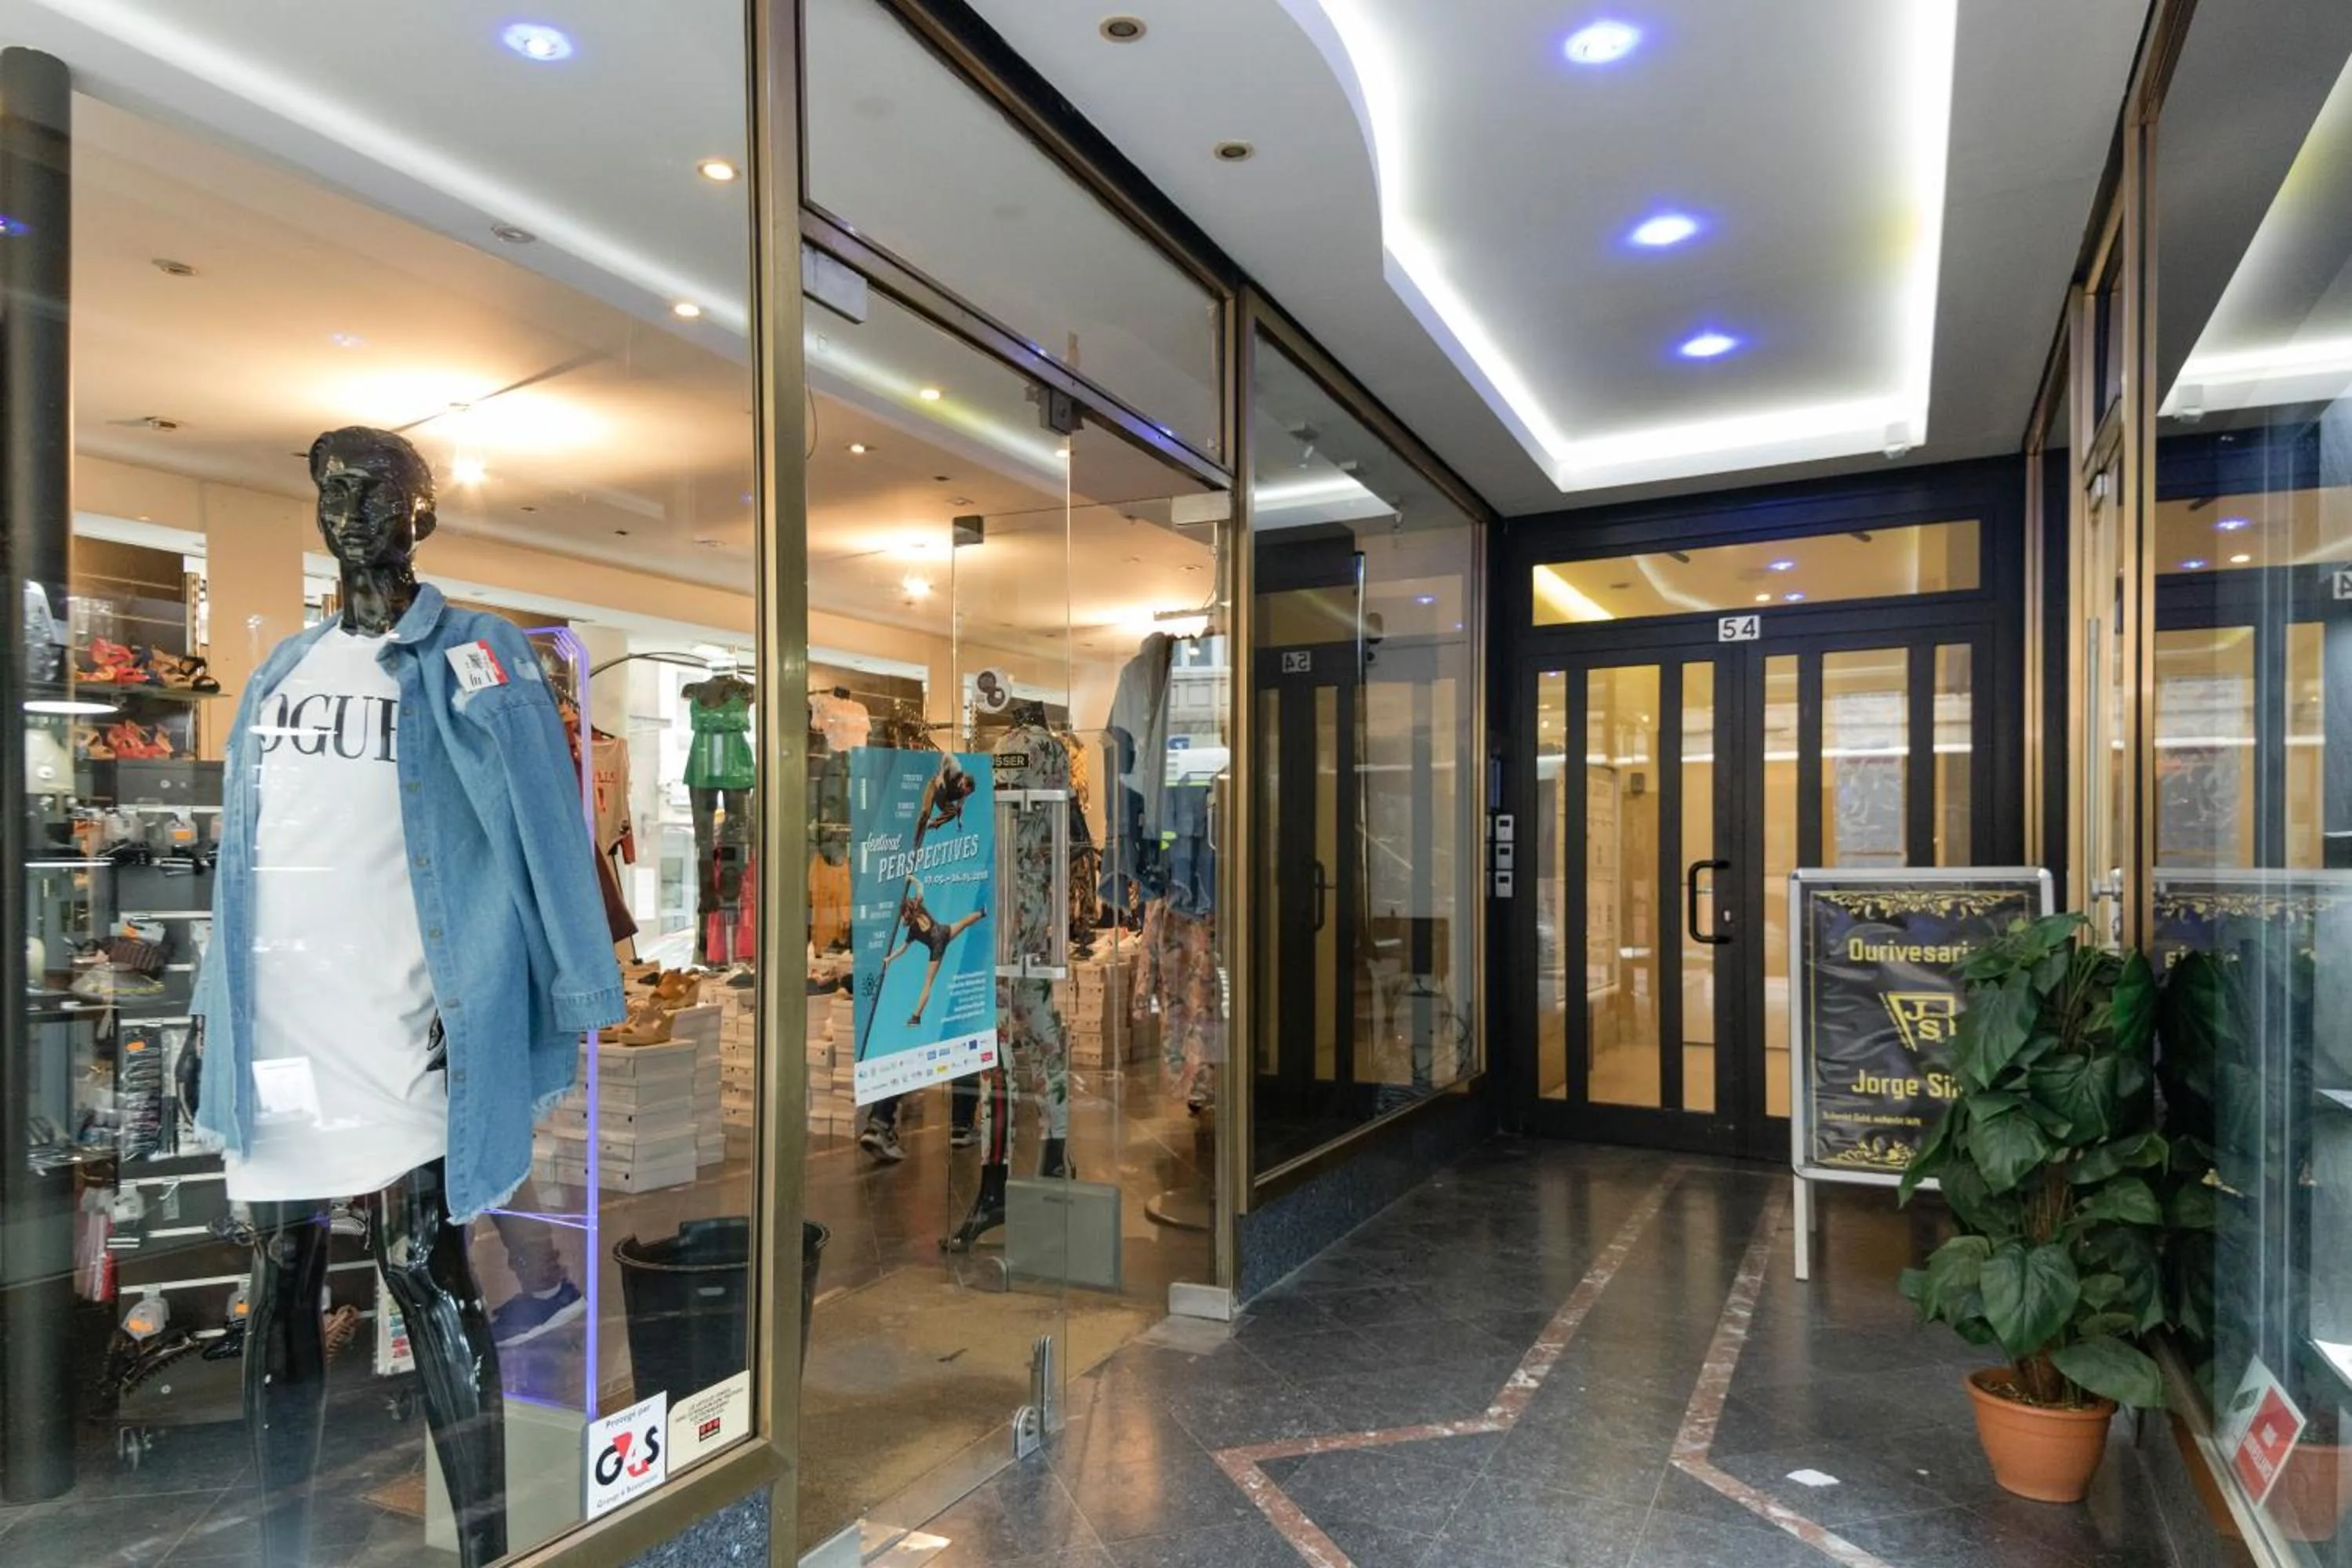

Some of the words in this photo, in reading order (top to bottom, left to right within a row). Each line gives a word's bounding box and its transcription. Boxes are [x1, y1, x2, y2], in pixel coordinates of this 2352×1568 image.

[1722, 618, 1756, 639] 54
[261, 692, 397, 763] OGUE
[993, 755, 1025, 767] SSER
[878, 834, 979, 883] PERSPECTIVES
[1848, 937, 1976, 963] Ourivesari
[1851, 1069, 1918, 1099] Jorge
